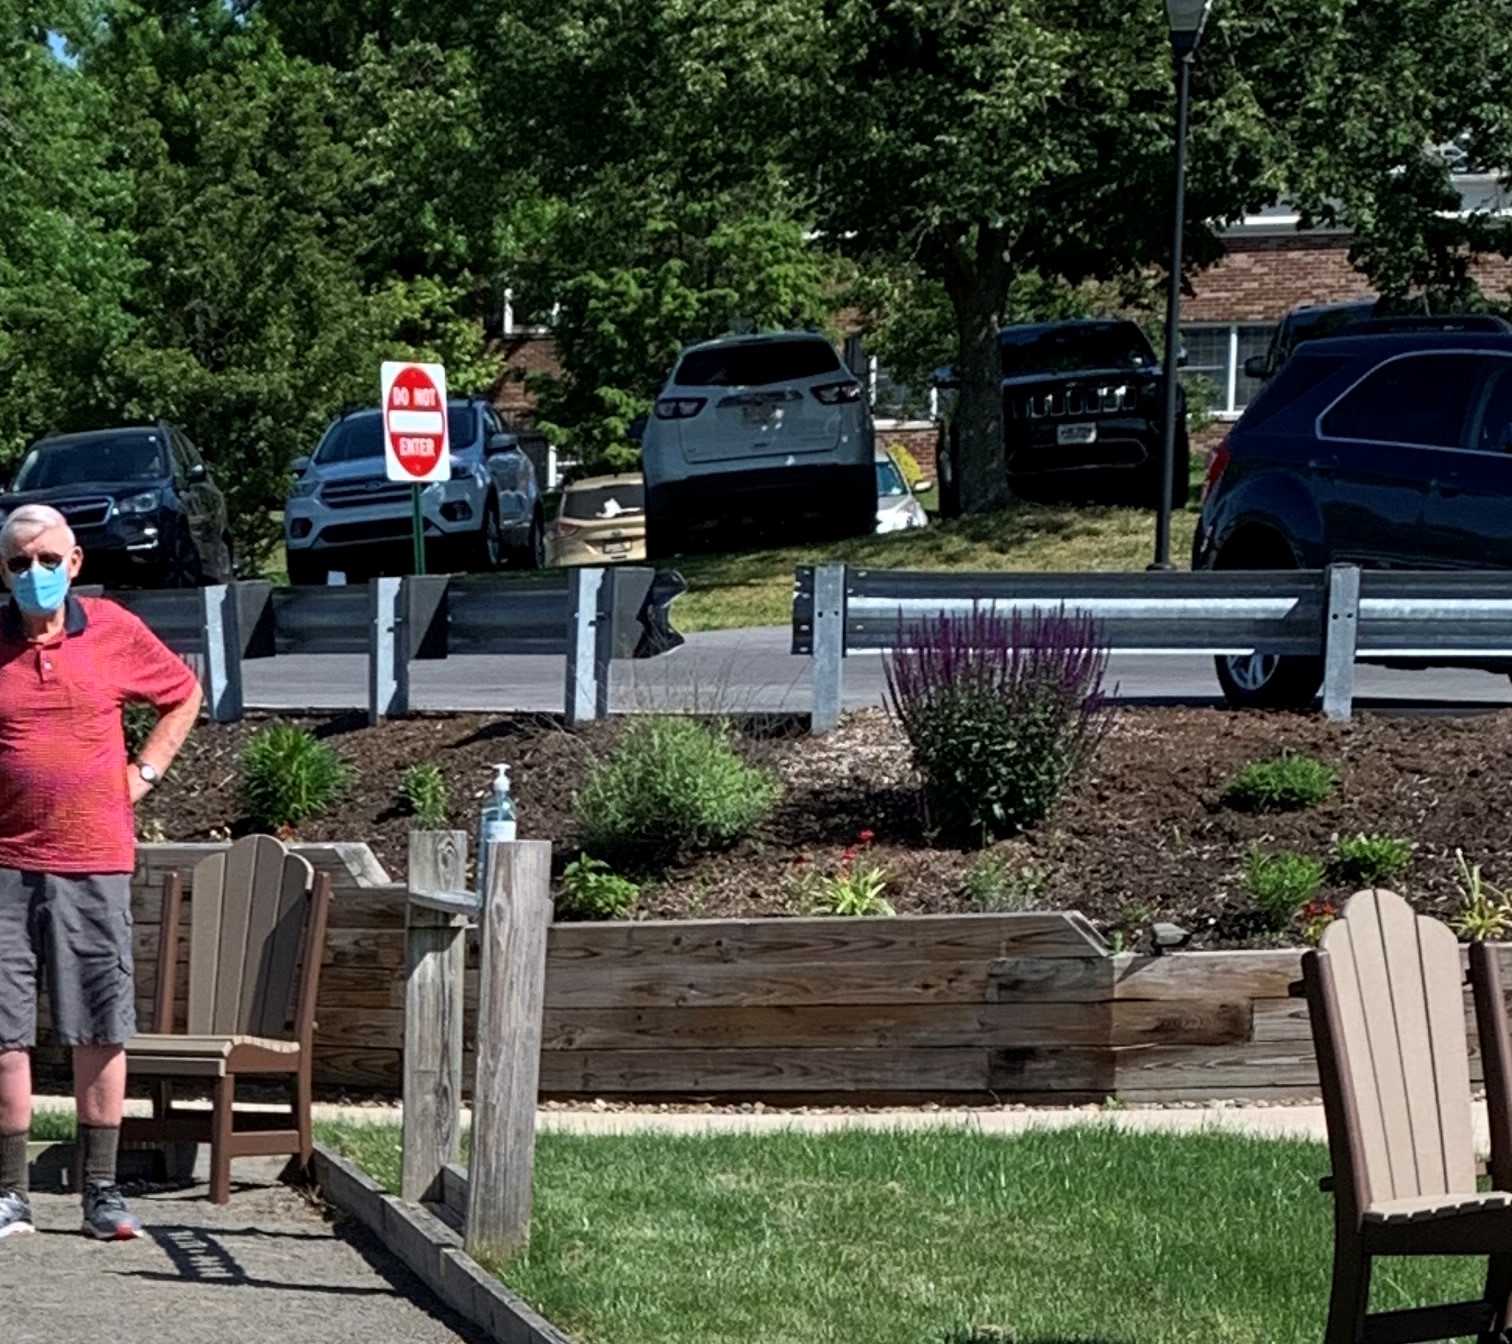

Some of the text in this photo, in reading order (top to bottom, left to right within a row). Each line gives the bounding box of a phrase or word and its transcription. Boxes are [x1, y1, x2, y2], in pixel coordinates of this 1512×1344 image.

[392, 386, 437, 407] DO NOT
[399, 437, 436, 457] ENTER
